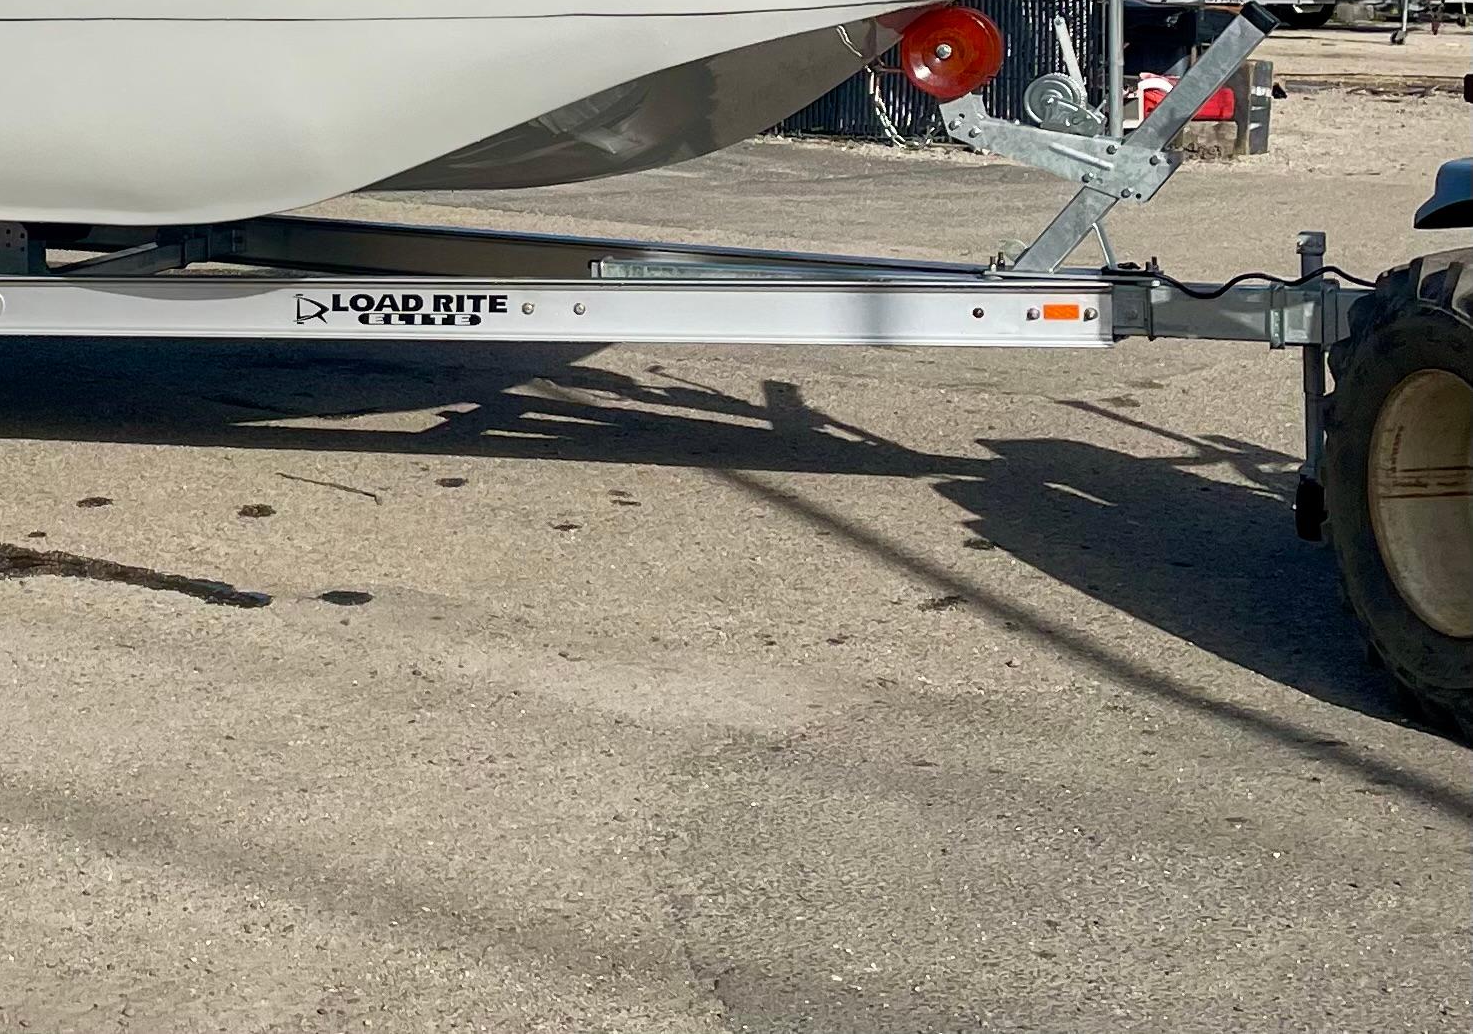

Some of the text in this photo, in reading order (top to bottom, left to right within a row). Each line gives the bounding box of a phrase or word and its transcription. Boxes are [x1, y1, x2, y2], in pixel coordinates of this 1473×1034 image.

[331, 293, 508, 313] LOAD RITE
[368, 313, 472, 325] ELITE
